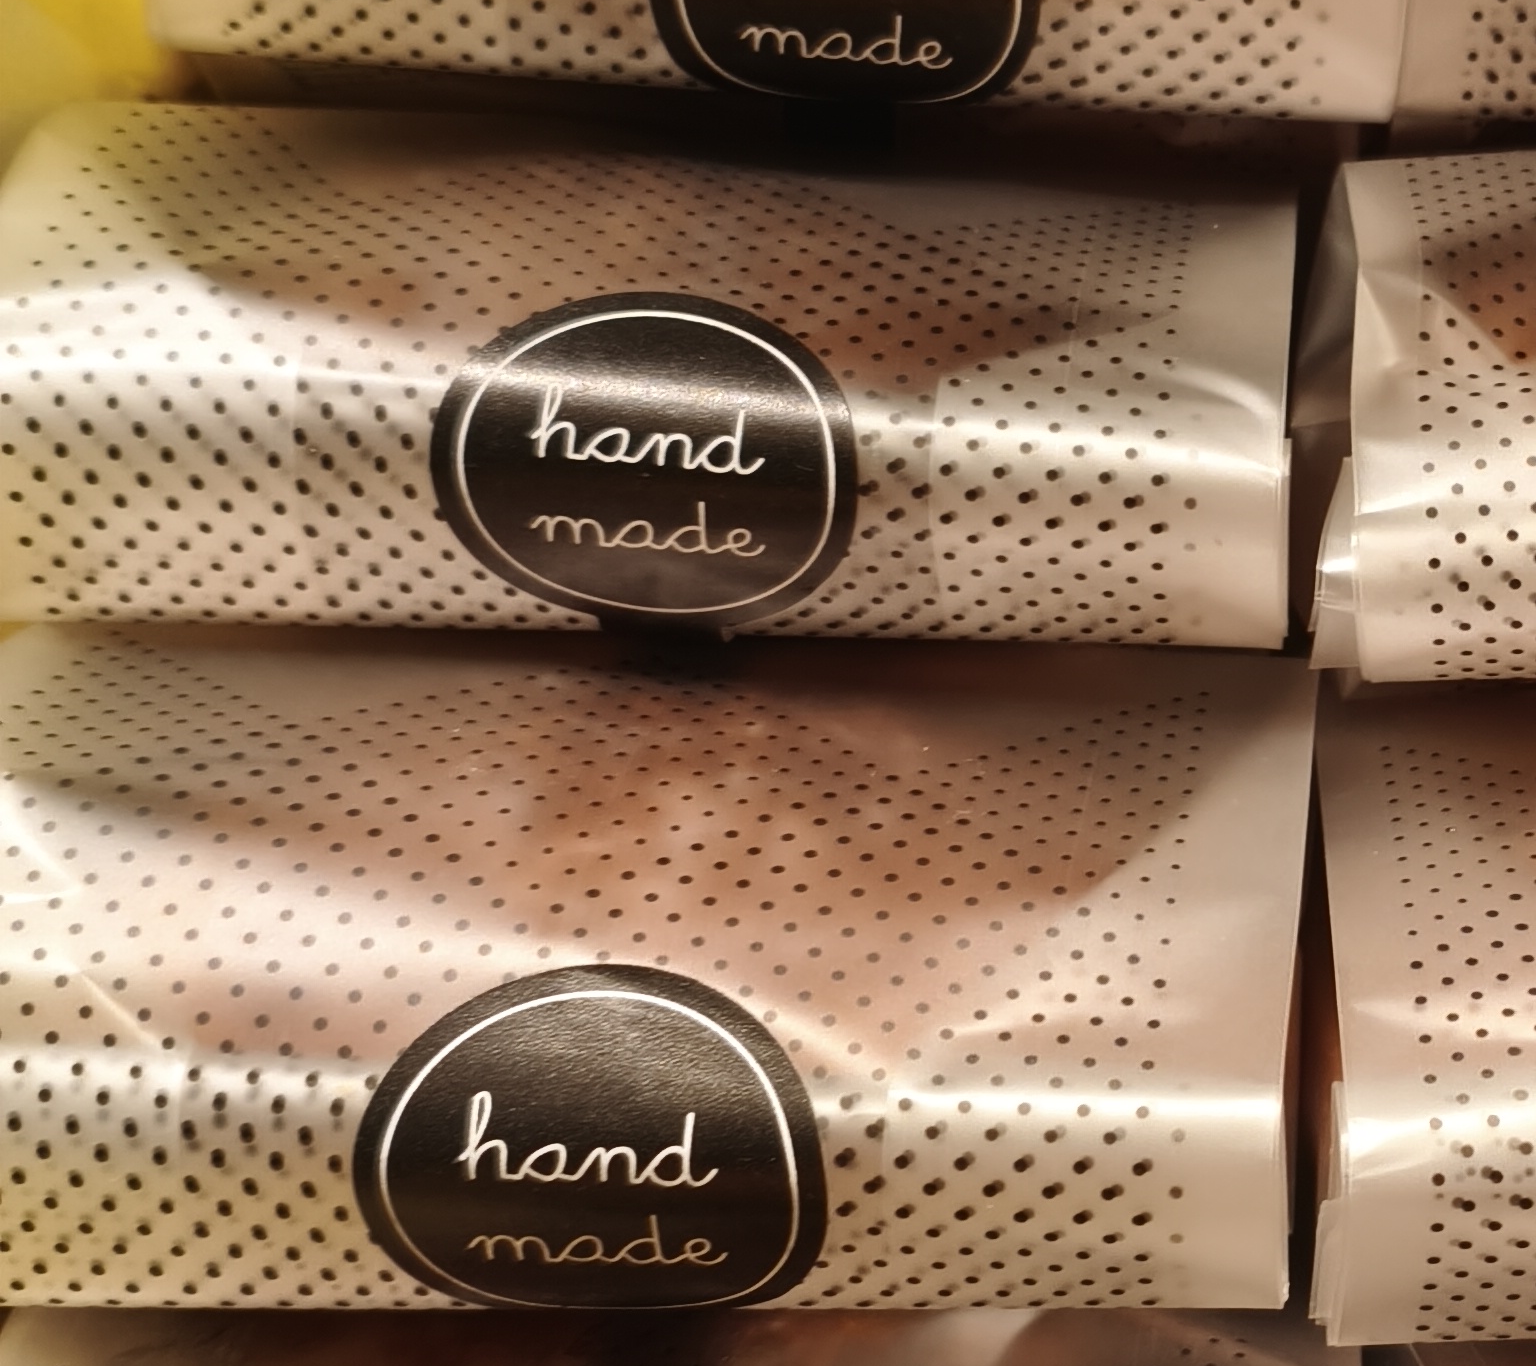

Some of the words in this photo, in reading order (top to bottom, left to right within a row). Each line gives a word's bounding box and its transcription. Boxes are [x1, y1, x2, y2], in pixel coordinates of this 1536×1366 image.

[739, 14, 954, 69] made
[529, 382, 766, 476] hand
[529, 501, 766, 558] made
[456, 1090, 719, 1188] hand
[465, 1214, 728, 1266] made
